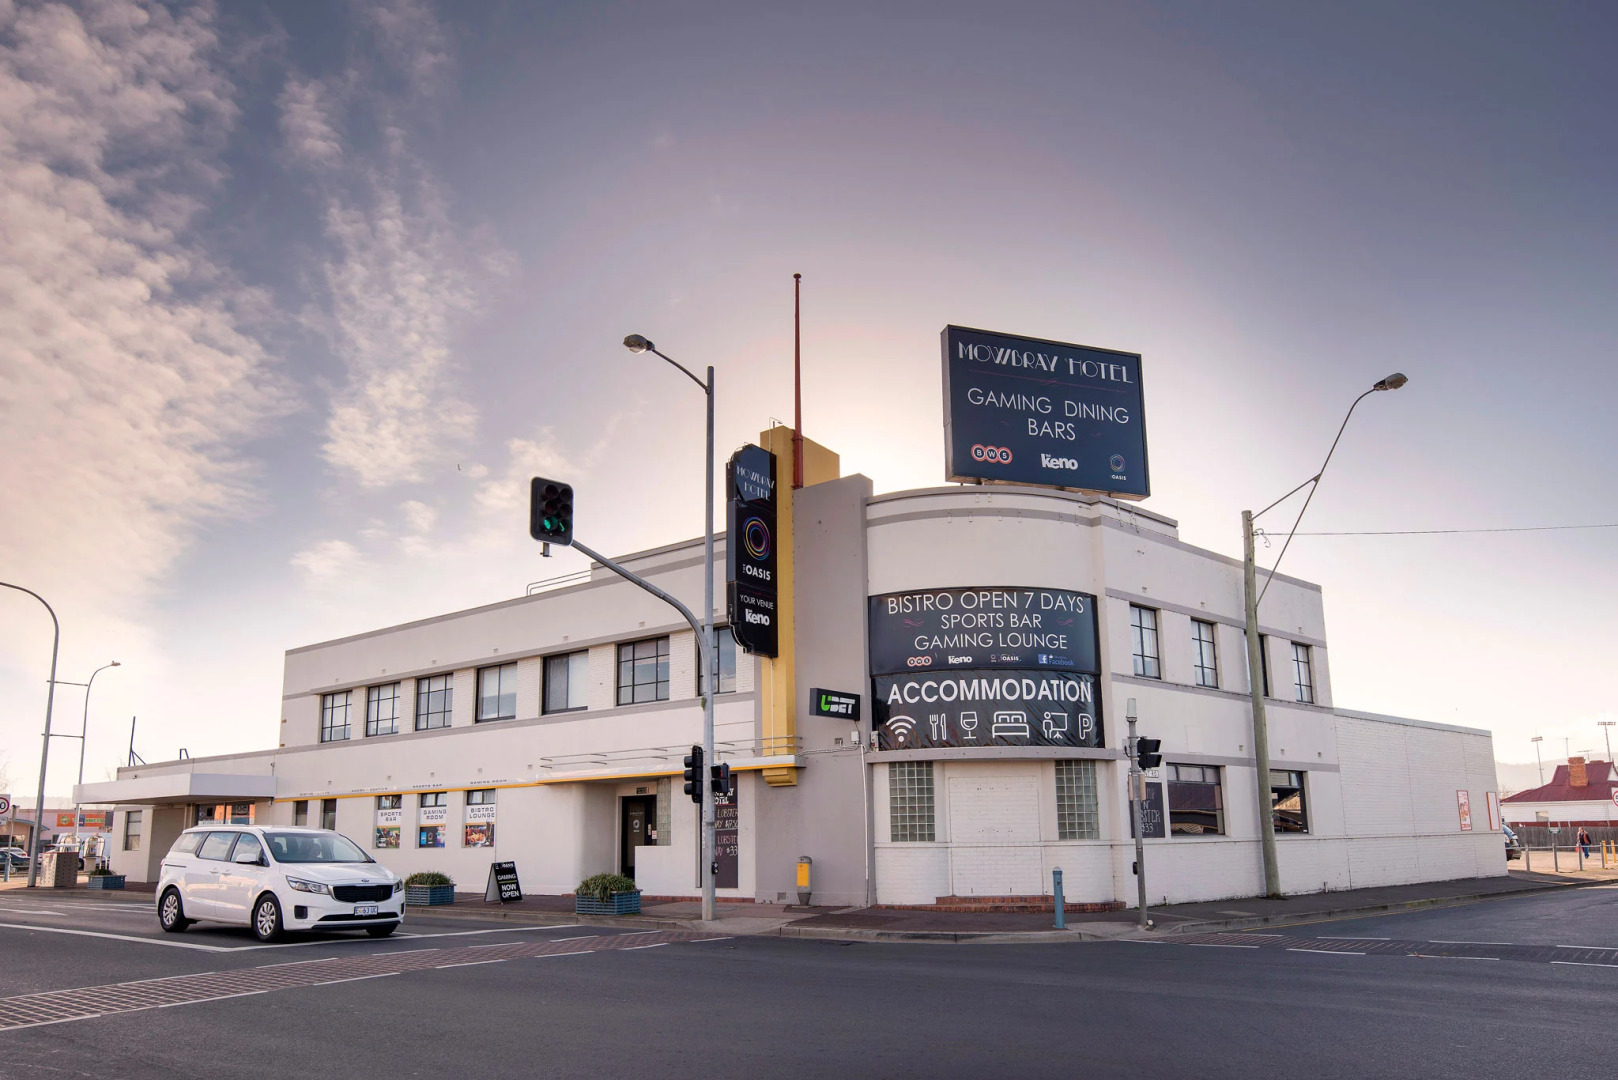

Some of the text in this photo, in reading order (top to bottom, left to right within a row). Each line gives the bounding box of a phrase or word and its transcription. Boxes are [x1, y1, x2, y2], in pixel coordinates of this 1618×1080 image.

[958, 341, 1133, 384] MOWBRAY HOTEL
[967, 387, 1129, 424] GAMING DINING
[1028, 418, 1076, 441] BARS
[974, 447, 1009, 461] BWS
[1040, 453, 1079, 470] keno
[744, 481, 770, 501] HOTEL
[745, 564, 771, 581] OASIS
[740, 594, 774, 610] YOUR VENUE
[888, 591, 1084, 615] BISTRO OPEN 7 DAYS
[745, 608, 770, 626] keno
[941, 613, 1043, 630] SPORTS BAR
[914, 632, 1068, 651] GAMING LOUNGE
[948, 655, 973, 664] keno
[887, 678, 1093, 705] ACCOMMODATION
[820, 694, 856, 714] UBET
[470, 806, 494, 814] BISTRO
[501, 883, 517, 891] NOW
